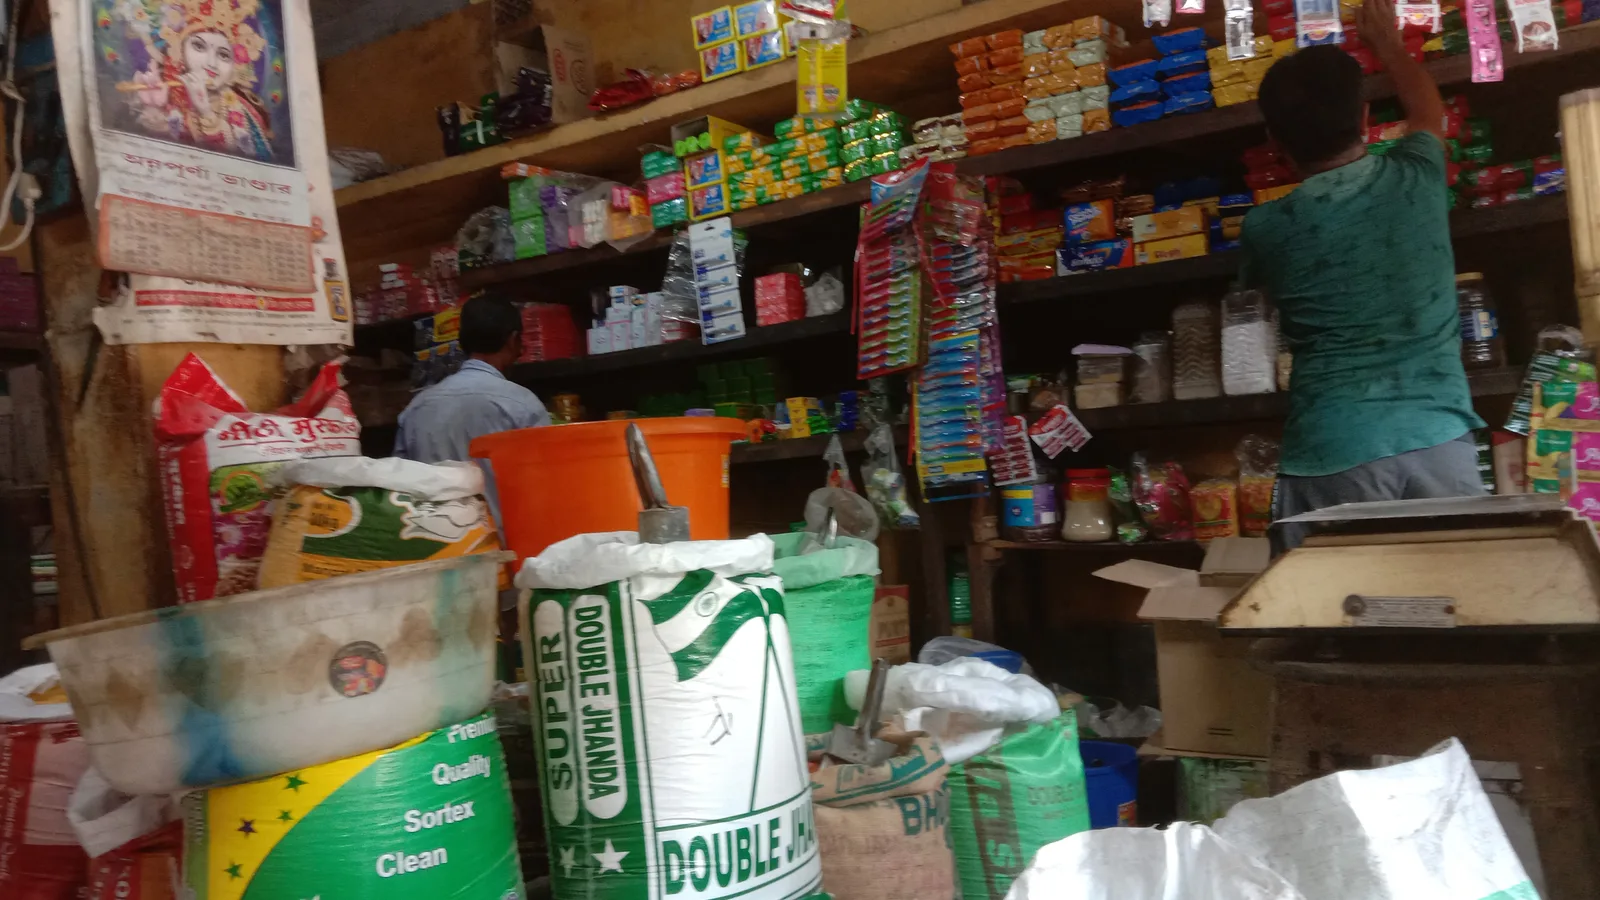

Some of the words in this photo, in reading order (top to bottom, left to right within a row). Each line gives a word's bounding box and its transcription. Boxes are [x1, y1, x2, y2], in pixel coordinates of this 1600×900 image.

[575, 604, 611, 699] DOUBLE
[540, 630, 574, 792] SUPER
[581, 701, 621, 801] JHANDA
[431, 754, 491, 786] Quality
[403, 800, 476, 833] Sortex
[661, 816, 782, 896] DOUBLE
[375, 847, 448, 878] Clean
